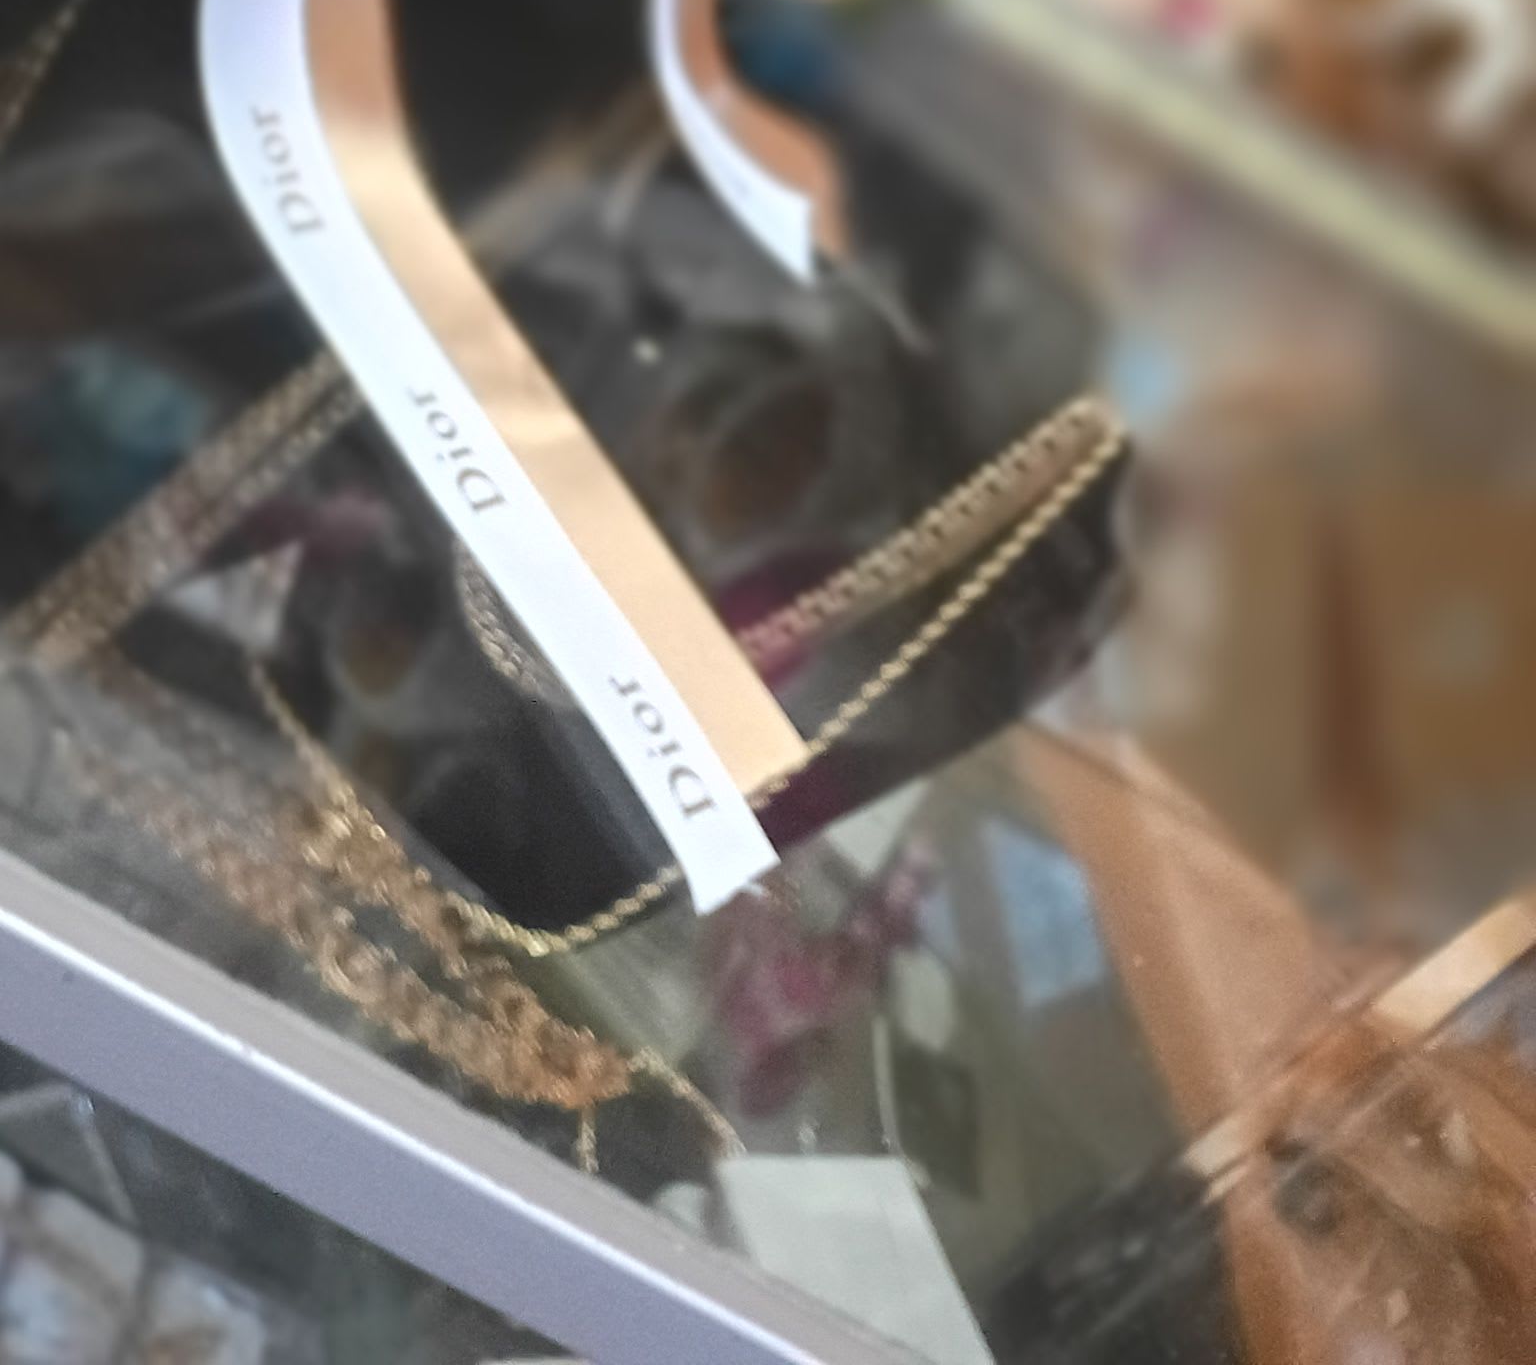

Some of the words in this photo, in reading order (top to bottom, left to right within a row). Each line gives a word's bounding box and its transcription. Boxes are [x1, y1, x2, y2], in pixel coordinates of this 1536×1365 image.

[249, 104, 325, 237] Dior
[405, 383, 507, 516] Dior
[608, 671, 718, 821] Dior
